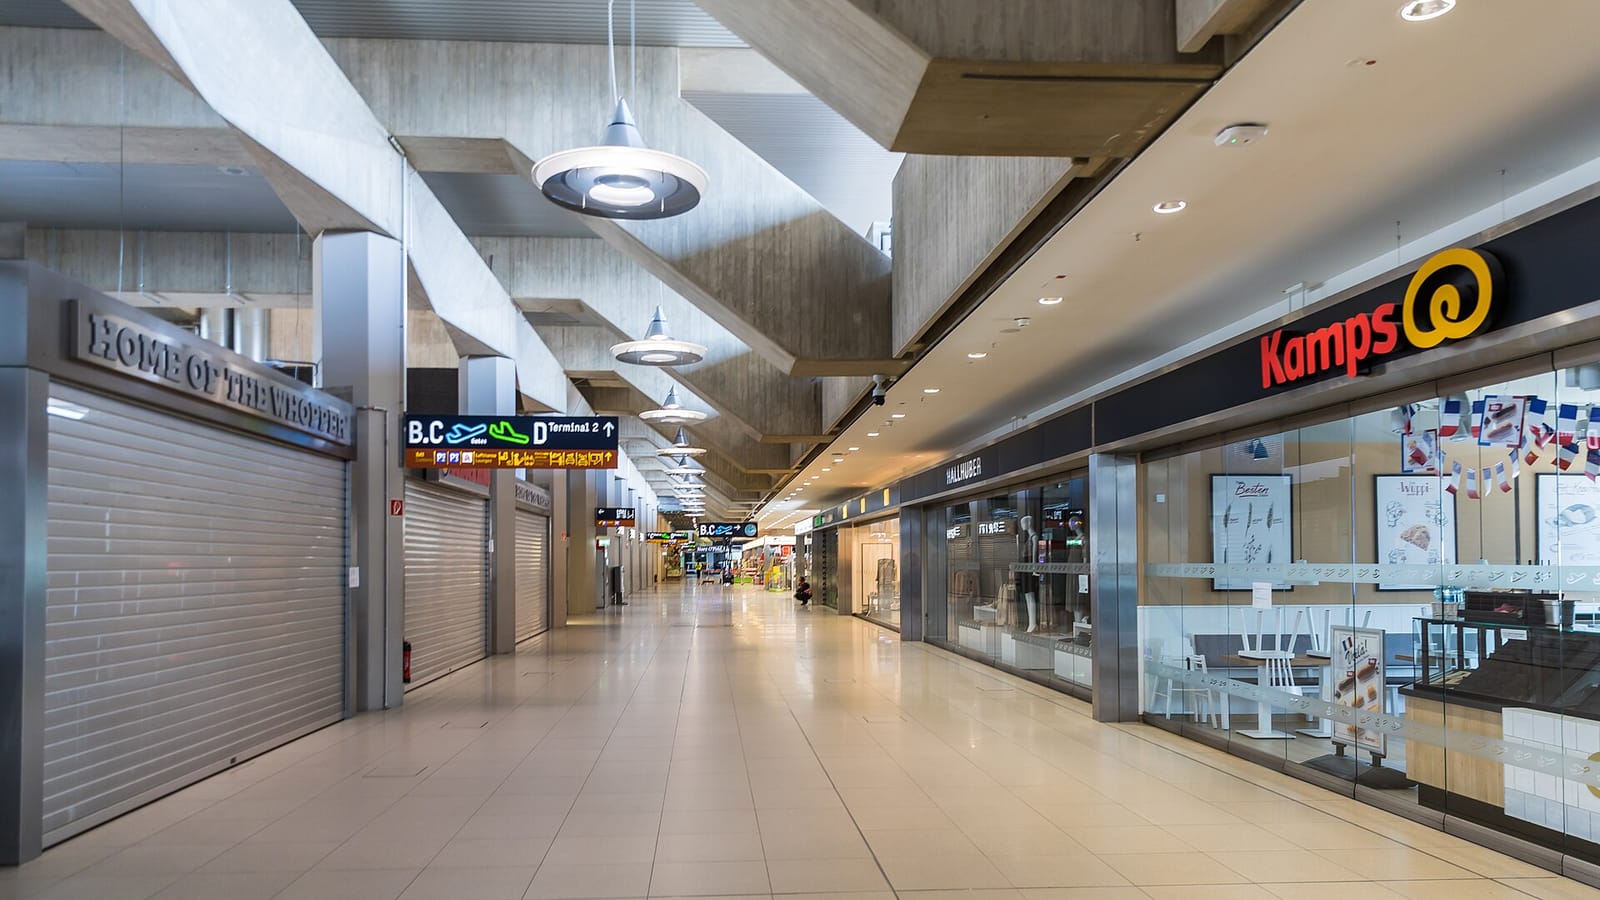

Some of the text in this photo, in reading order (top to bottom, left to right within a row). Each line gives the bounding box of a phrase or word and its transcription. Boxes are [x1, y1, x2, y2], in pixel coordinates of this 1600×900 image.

[1260, 303, 1398, 389] Kamps
[89, 313, 345, 439] HOME OF THE WHOPPER
[533, 421, 548, 445] D
[548, 421, 599, 433] Terminal 2
[946, 456, 982, 485] HALLHUBER
[1235, 481, 1269, 496] Besten
